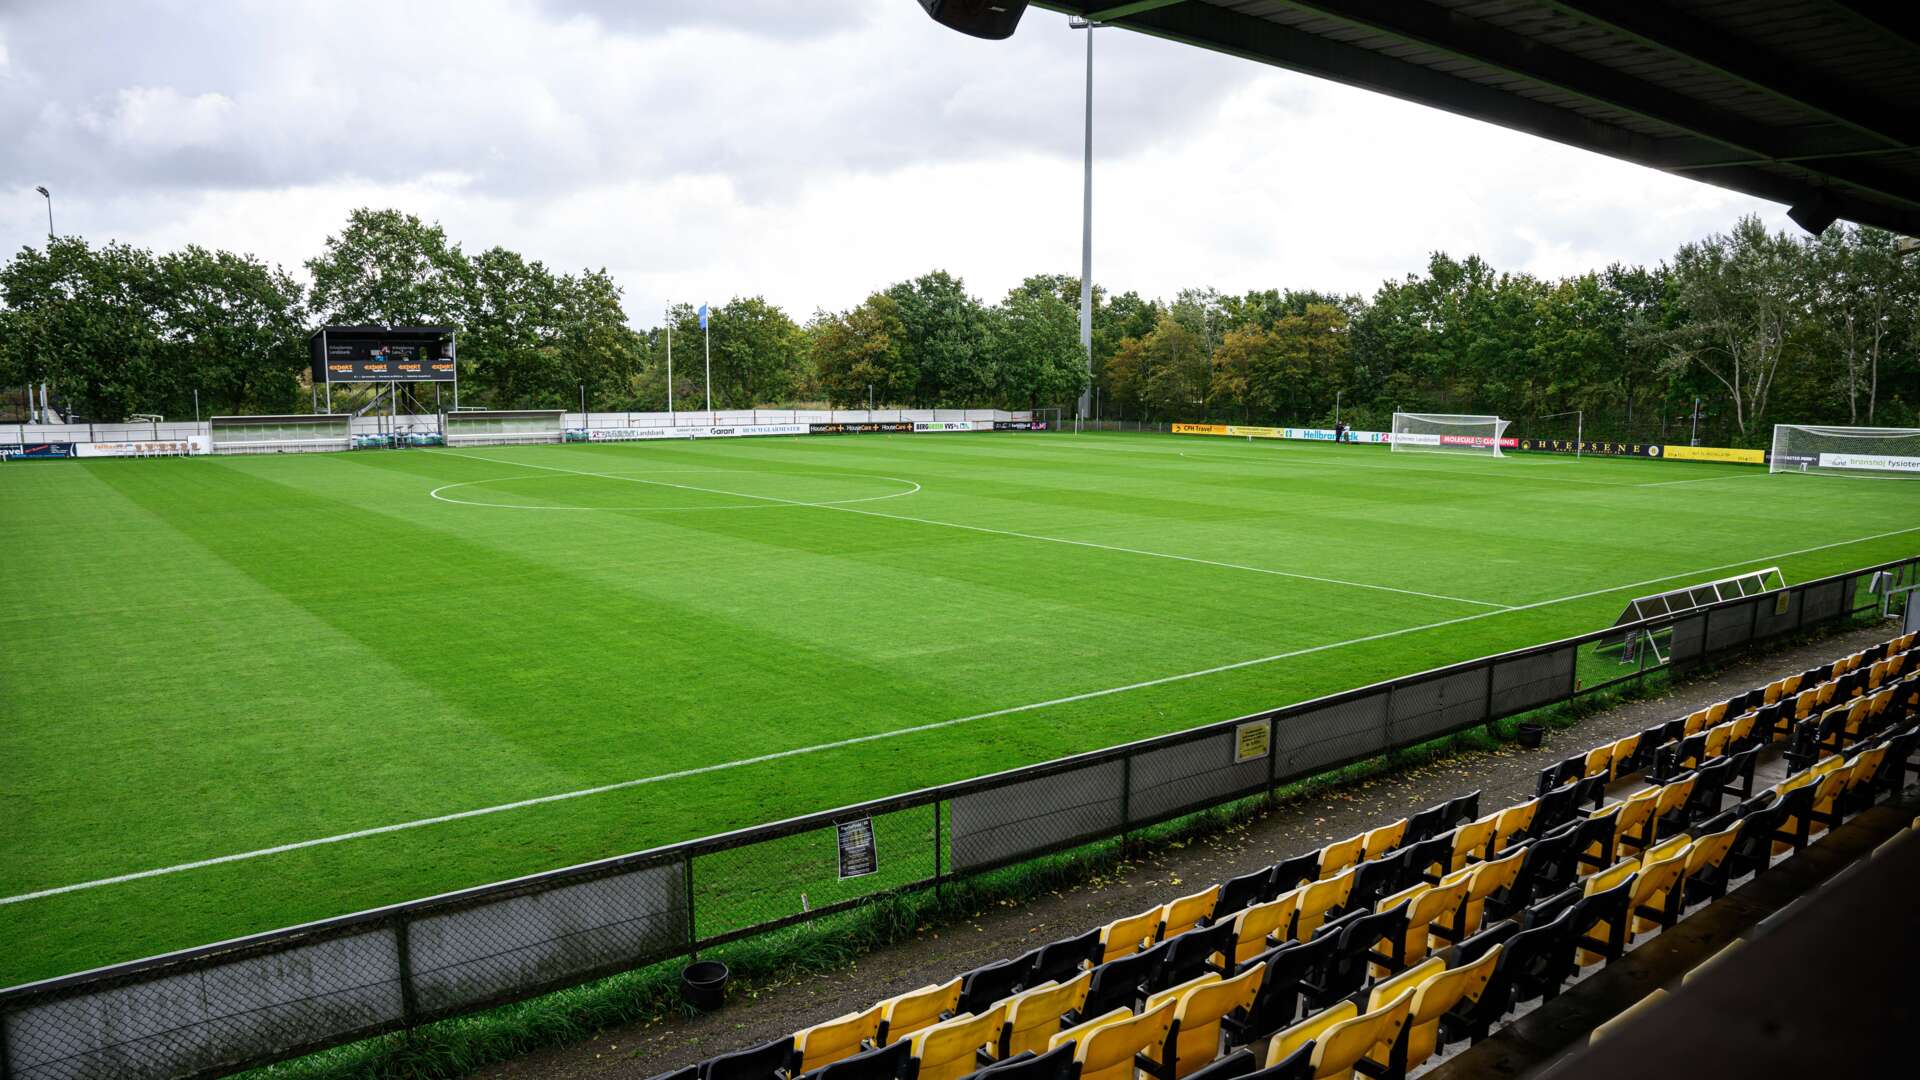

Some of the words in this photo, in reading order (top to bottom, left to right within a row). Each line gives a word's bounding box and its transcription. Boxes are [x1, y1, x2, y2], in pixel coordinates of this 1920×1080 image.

[710, 427, 735, 435] Garant
[1195, 425, 1212, 433] Travel
[1483, 438, 1515, 446] CLOING
[0, 445, 24, 455] avel
